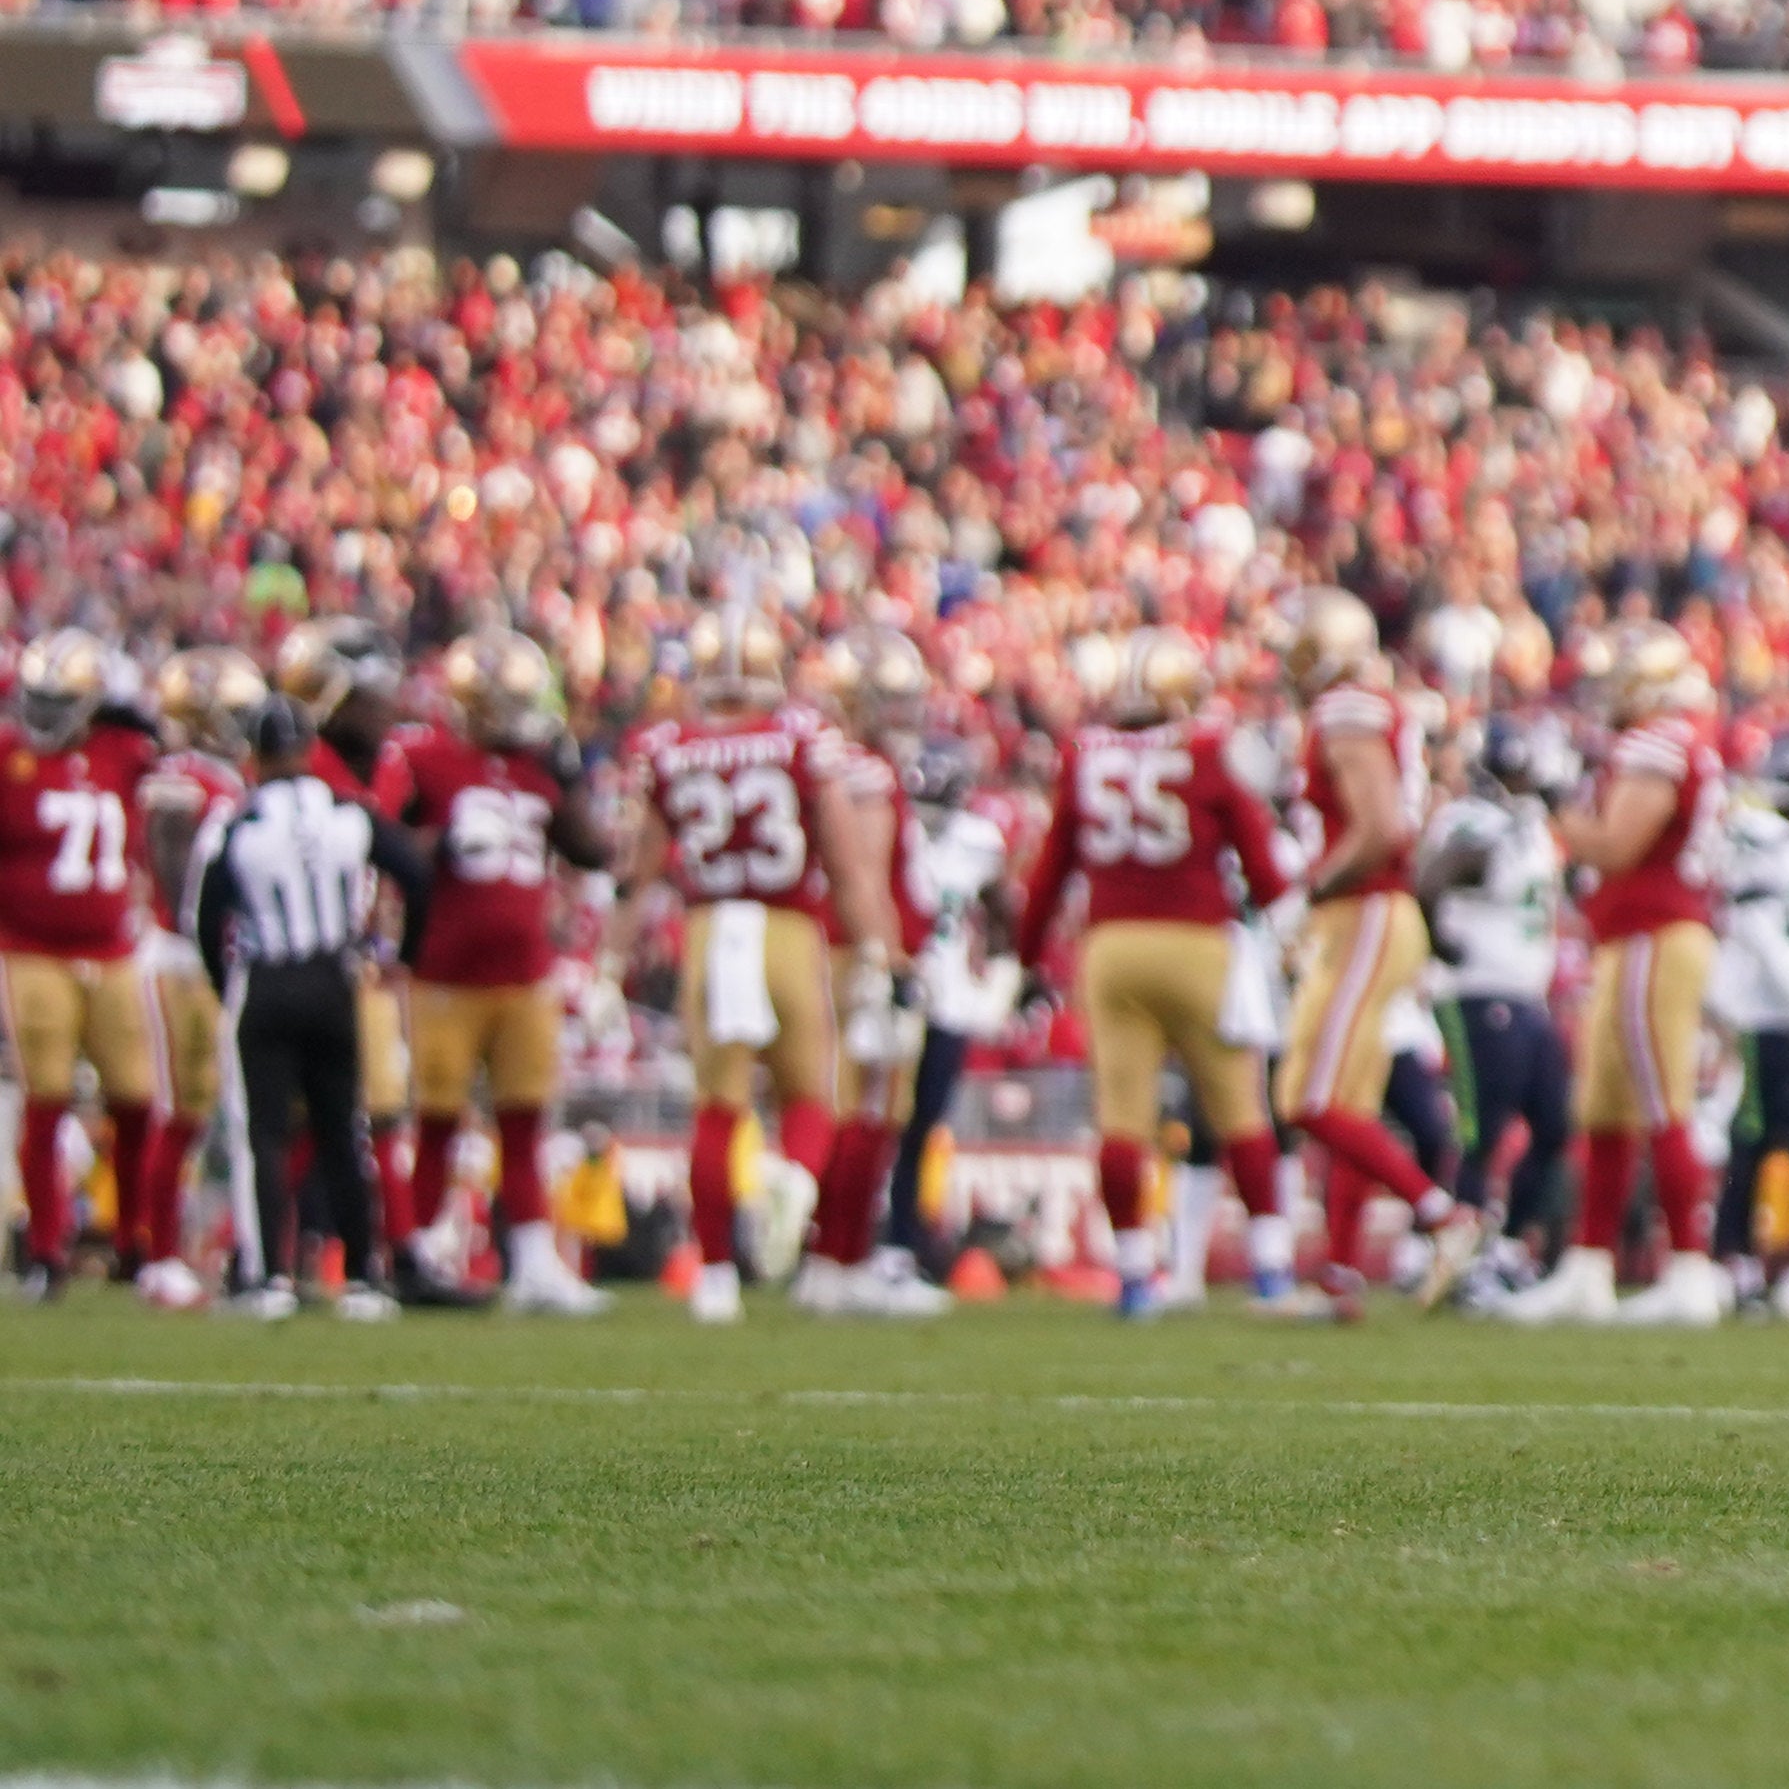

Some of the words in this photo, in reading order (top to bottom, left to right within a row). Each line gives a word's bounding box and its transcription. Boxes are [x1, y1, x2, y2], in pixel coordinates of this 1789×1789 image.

[36, 789, 129, 895] 71
[666, 763, 808, 897] 23
[1074, 741, 1197, 869] 55
